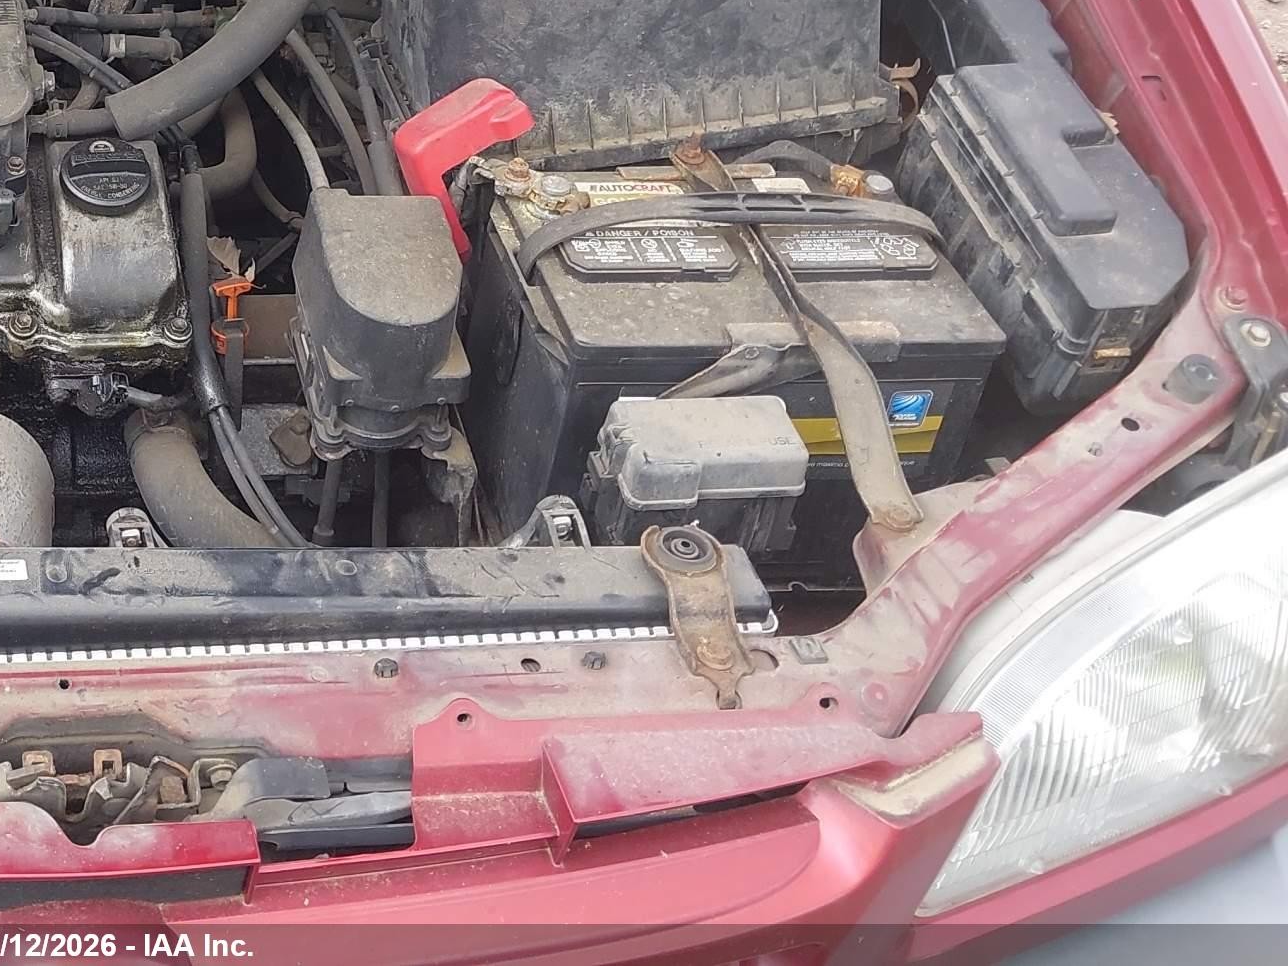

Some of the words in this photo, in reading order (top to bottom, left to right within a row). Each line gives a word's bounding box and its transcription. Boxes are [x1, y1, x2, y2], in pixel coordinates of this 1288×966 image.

[598, 184, 671, 193] AUTOCRAFT
[596, 229, 642, 237] DANGER
[652, 229, 695, 237] POISON
